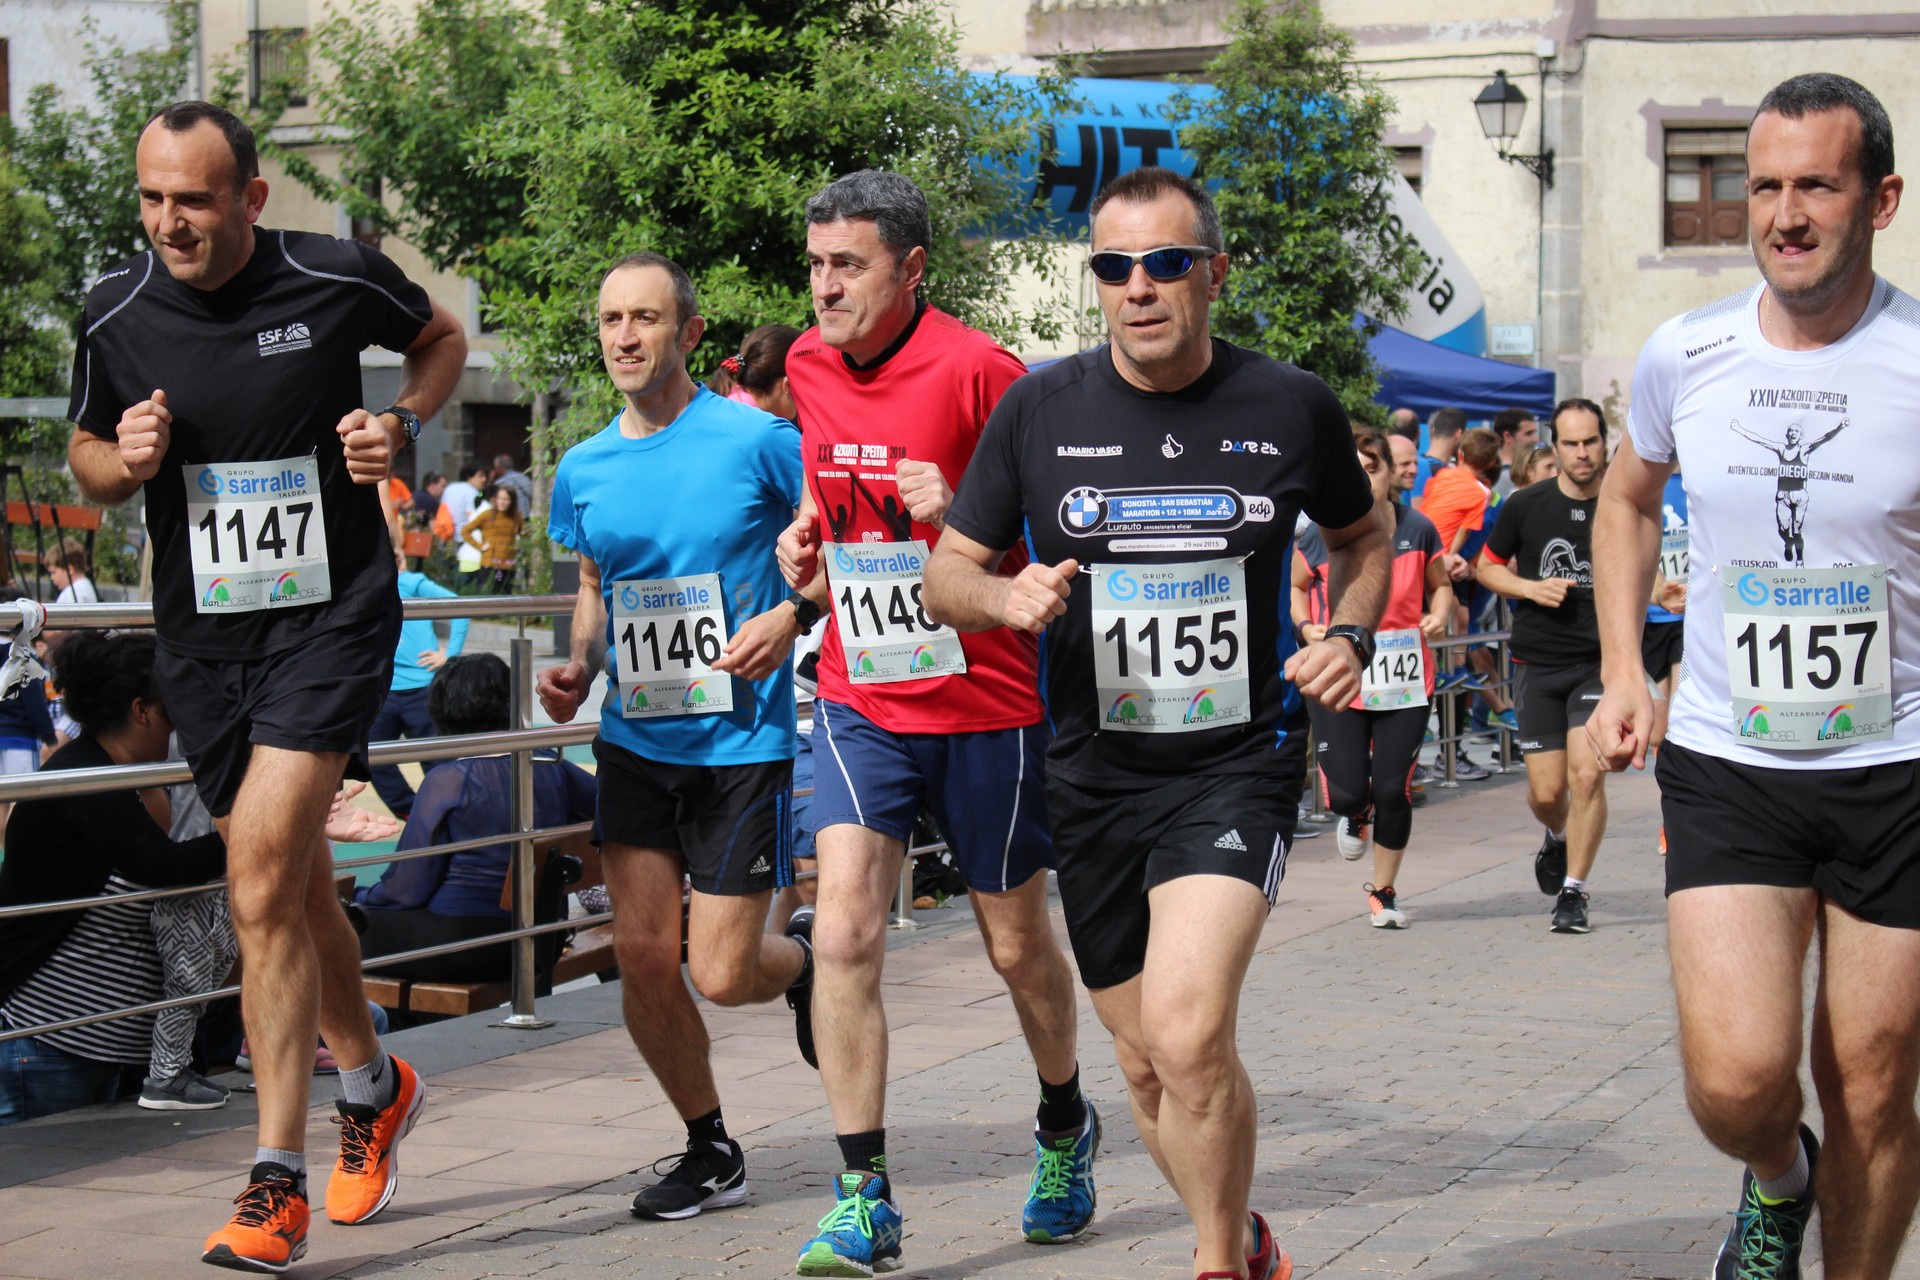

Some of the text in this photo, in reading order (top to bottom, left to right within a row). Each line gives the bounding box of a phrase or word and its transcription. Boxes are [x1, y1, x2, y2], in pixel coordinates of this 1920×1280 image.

[257, 328, 282, 346] ESF
[1686, 338, 1723, 359] luanvi
[1748, 388, 1779, 408] XXIV
[817, 443, 833, 463] XXV
[889, 446, 906, 459] 2018
[1057, 445, 1123, 454] EL DIARIO VASCO
[229, 470, 306, 494] sarralle
[1727, 464, 1854, 484] AUTÉNTICO COMO DIEGO BEZAIN HANDIA
[278, 490, 307, 498] TALDEA
[1066, 490, 1105, 504] BMW
[1122, 499, 1157, 508] DONOSTIA
[1161, 499, 1175, 507] SAN
[1175, 497, 1213, 507] SEBASTIÁN
[1122, 509, 1160, 518] MARATHON
[1183, 508, 1202, 516] 10KM
[1248, 501, 1271, 518] edp
[200, 502, 313, 563] 1147
[1107, 523, 1142, 531] Lurauto
[857, 553, 920, 573] sarralle
[1738, 560, 1778, 569] EUSKADI
[1143, 573, 1231, 601] sarralle
[1774, 581, 1871, 606] sarralle
[643, 586, 709, 609] sarralle
[1200, 596, 1231, 605] TALDEA
[622, 617, 721, 672] 1146
[1105, 610, 1239, 677] 1155
[1380, 635, 1415, 648] sarralle
[1737, 621, 1878, 690] 1157
[1370, 653, 1419, 685] 1142
[1214, 841, 1247, 851] adidas
[750, 865, 771, 874] adidas
